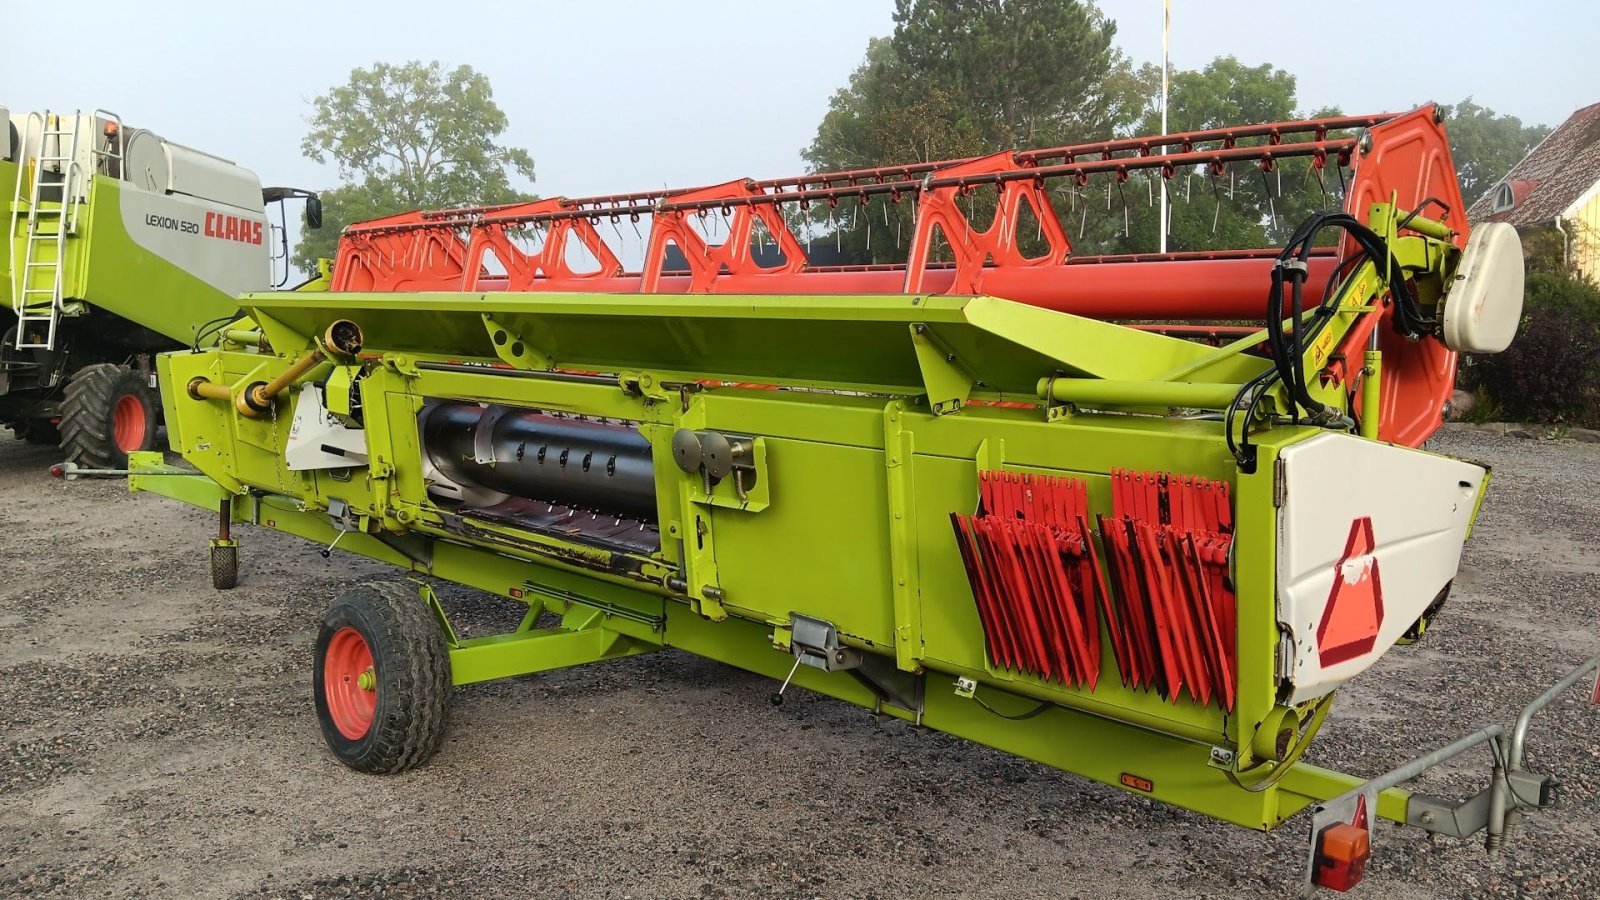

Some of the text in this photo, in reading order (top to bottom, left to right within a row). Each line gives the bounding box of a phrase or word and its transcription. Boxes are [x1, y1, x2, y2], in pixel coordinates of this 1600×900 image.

[146, 214, 199, 234] LEXION 520
[204, 211, 262, 245] CLAAS
